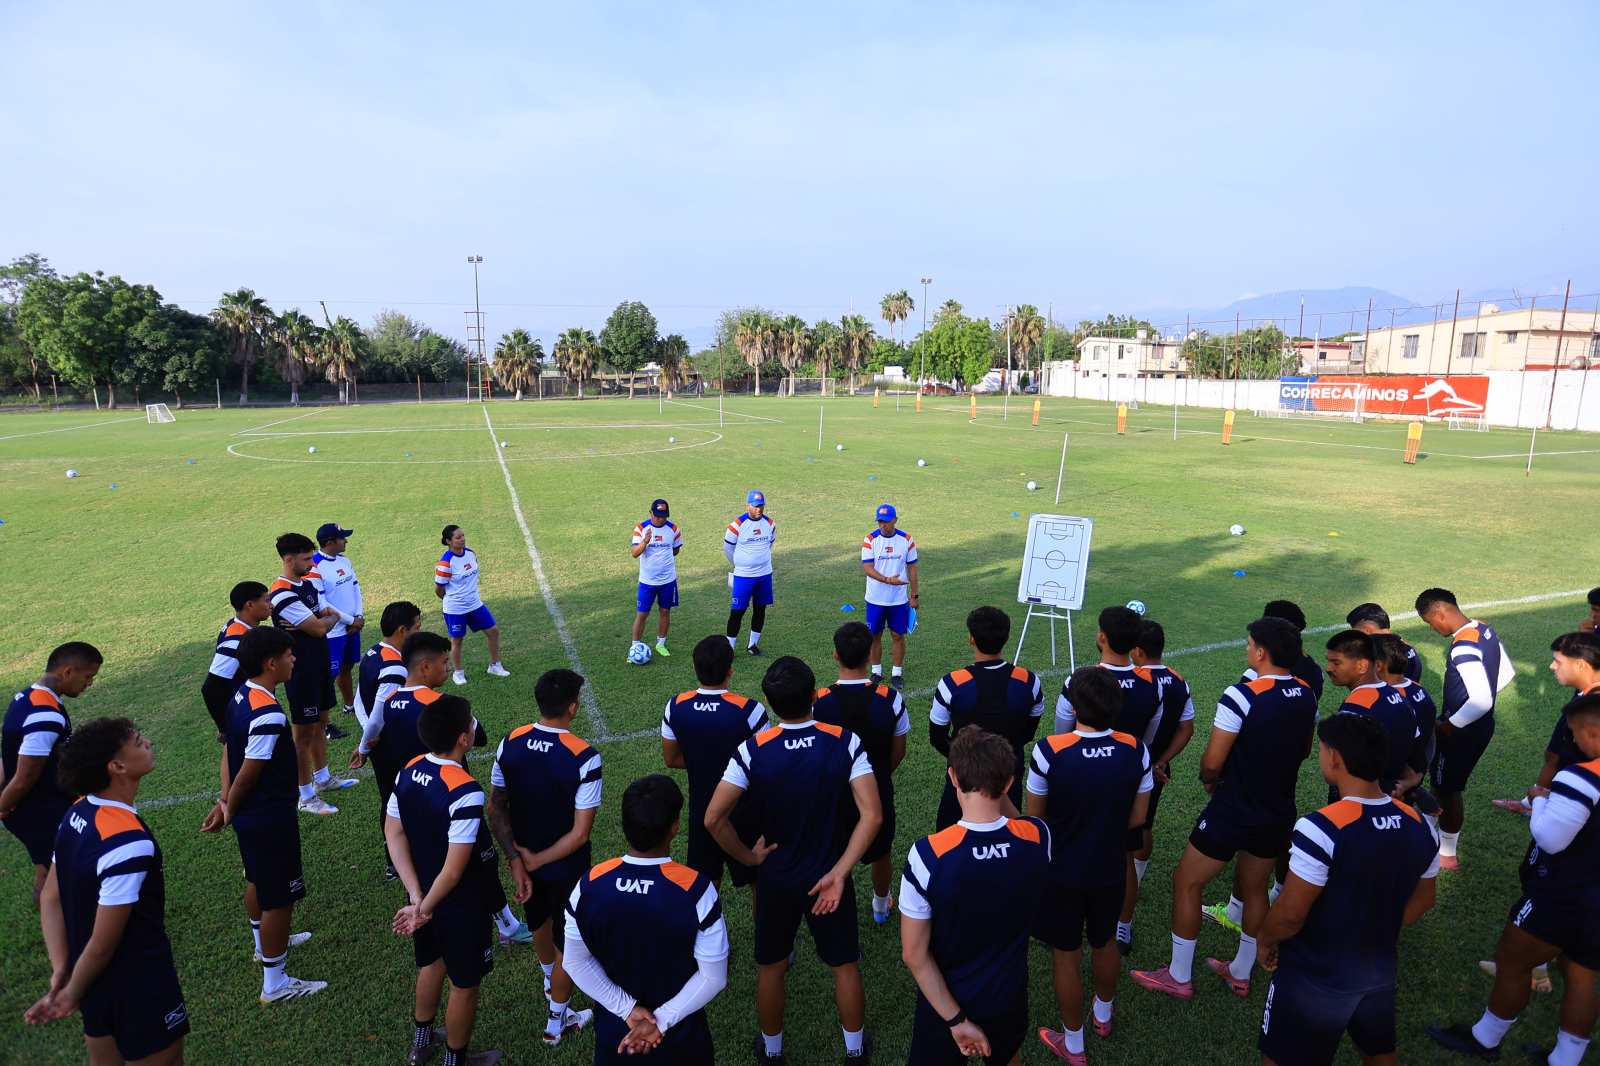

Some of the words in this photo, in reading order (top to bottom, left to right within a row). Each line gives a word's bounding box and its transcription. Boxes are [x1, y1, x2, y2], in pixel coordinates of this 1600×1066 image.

[1281, 386, 1409, 402] CORRECAMINOS
[1282, 687, 1302, 697] UAT
[390, 700, 410, 710] UAT
[694, 702, 720, 712] UAT
[526, 739, 553, 753] UAT
[784, 736, 815, 750] UAT
[1082, 745, 1115, 758] UAT
[411, 769, 433, 787] UAT
[69, 812, 88, 834] UAT
[1371, 815, 1402, 830] UAT
[972, 842, 1010, 860] UAT
[615, 877, 654, 895] UAT
